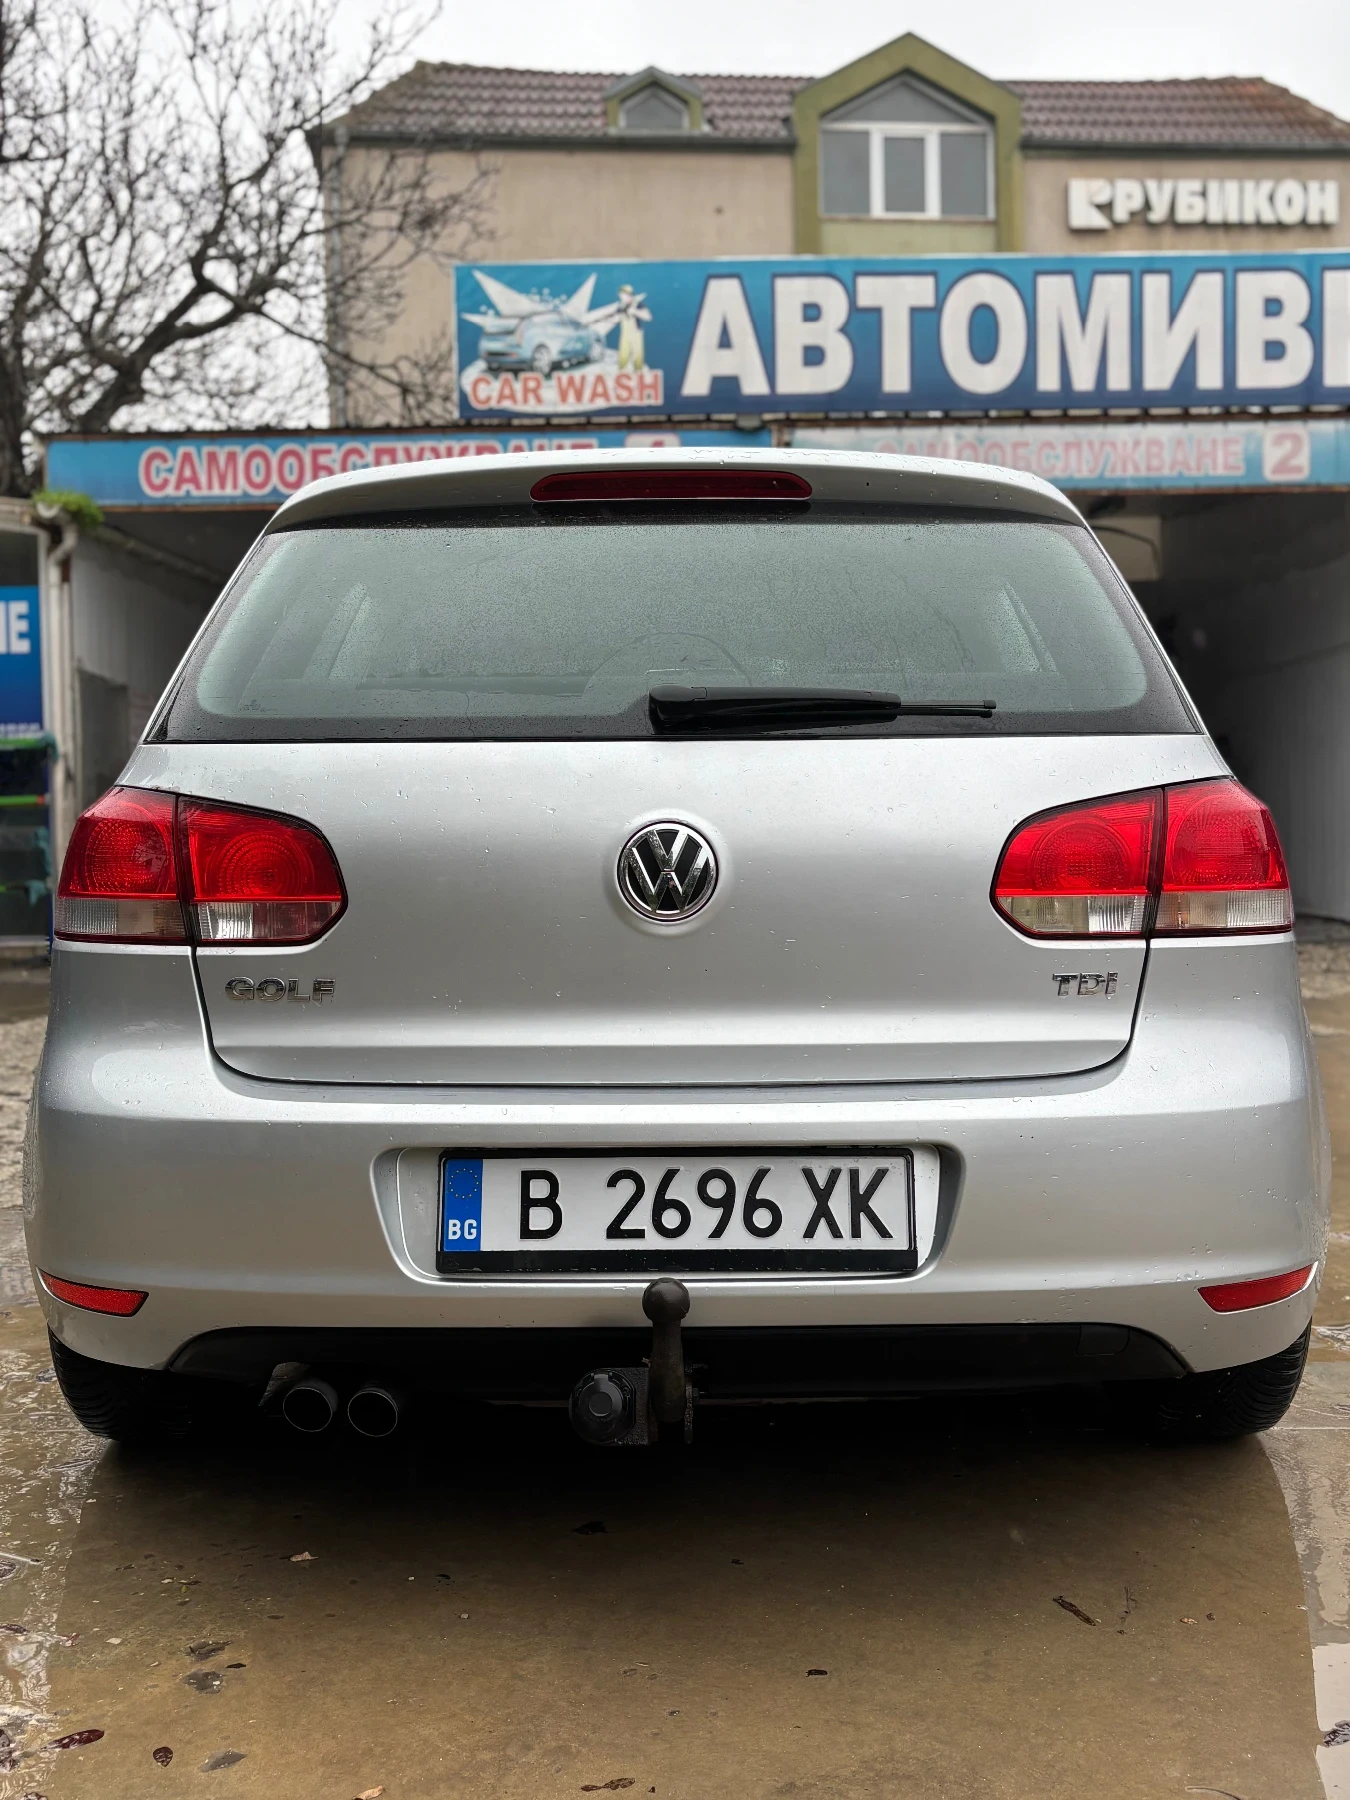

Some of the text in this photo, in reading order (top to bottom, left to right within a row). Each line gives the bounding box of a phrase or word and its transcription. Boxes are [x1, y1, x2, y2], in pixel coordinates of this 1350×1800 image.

[470, 371, 661, 407] CAR WASH
[1270, 432, 1305, 476] 2
[225, 976, 335, 1002] GOLF
[519, 1167, 894, 1240] B 2696 XK
[447, 1218, 478, 1240] BG
